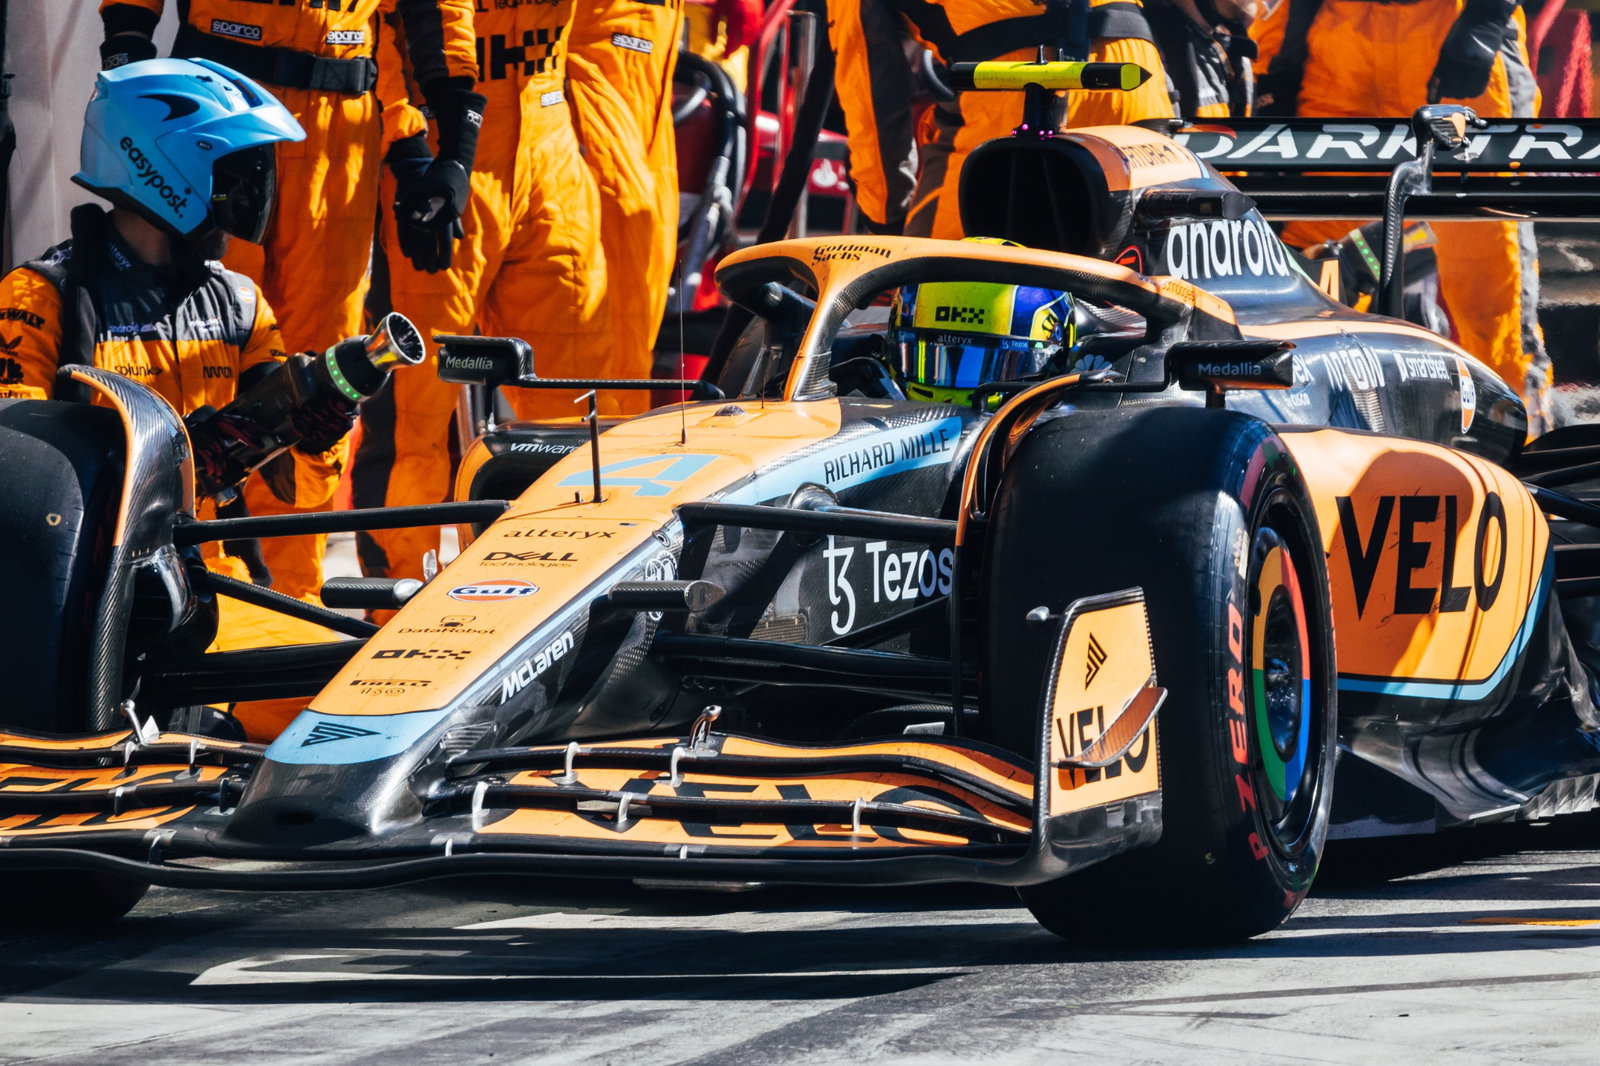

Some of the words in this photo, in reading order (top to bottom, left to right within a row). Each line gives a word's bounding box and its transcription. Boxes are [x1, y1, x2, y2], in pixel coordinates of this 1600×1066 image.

[212, 20, 261, 39] sparco
[1173, 124, 1600, 160] DARKTR
[814, 244, 891, 258] Goldman
[1166, 218, 1291, 280] android
[811, 253, 862, 265] Sachs
[935, 306, 985, 325] OKX
[937, 333, 973, 344] alteryx
[446, 357, 493, 370] Medallia
[1199, 362, 1261, 376] Medallia
[824, 440, 896, 485] RICHARD
[900, 428, 951, 462] MILLE
[556, 454, 721, 497] 4
[503, 528, 617, 540] alteryx
[483, 551, 578, 562] DELL
[1335, 491, 1507, 622] VELO
[866, 541, 953, 604] Tezos
[453, 586, 536, 595] Gulf
[371, 649, 472, 660] OKX
[501, 631, 574, 705] McLaren
[1227, 603, 1258, 813] ZERO
